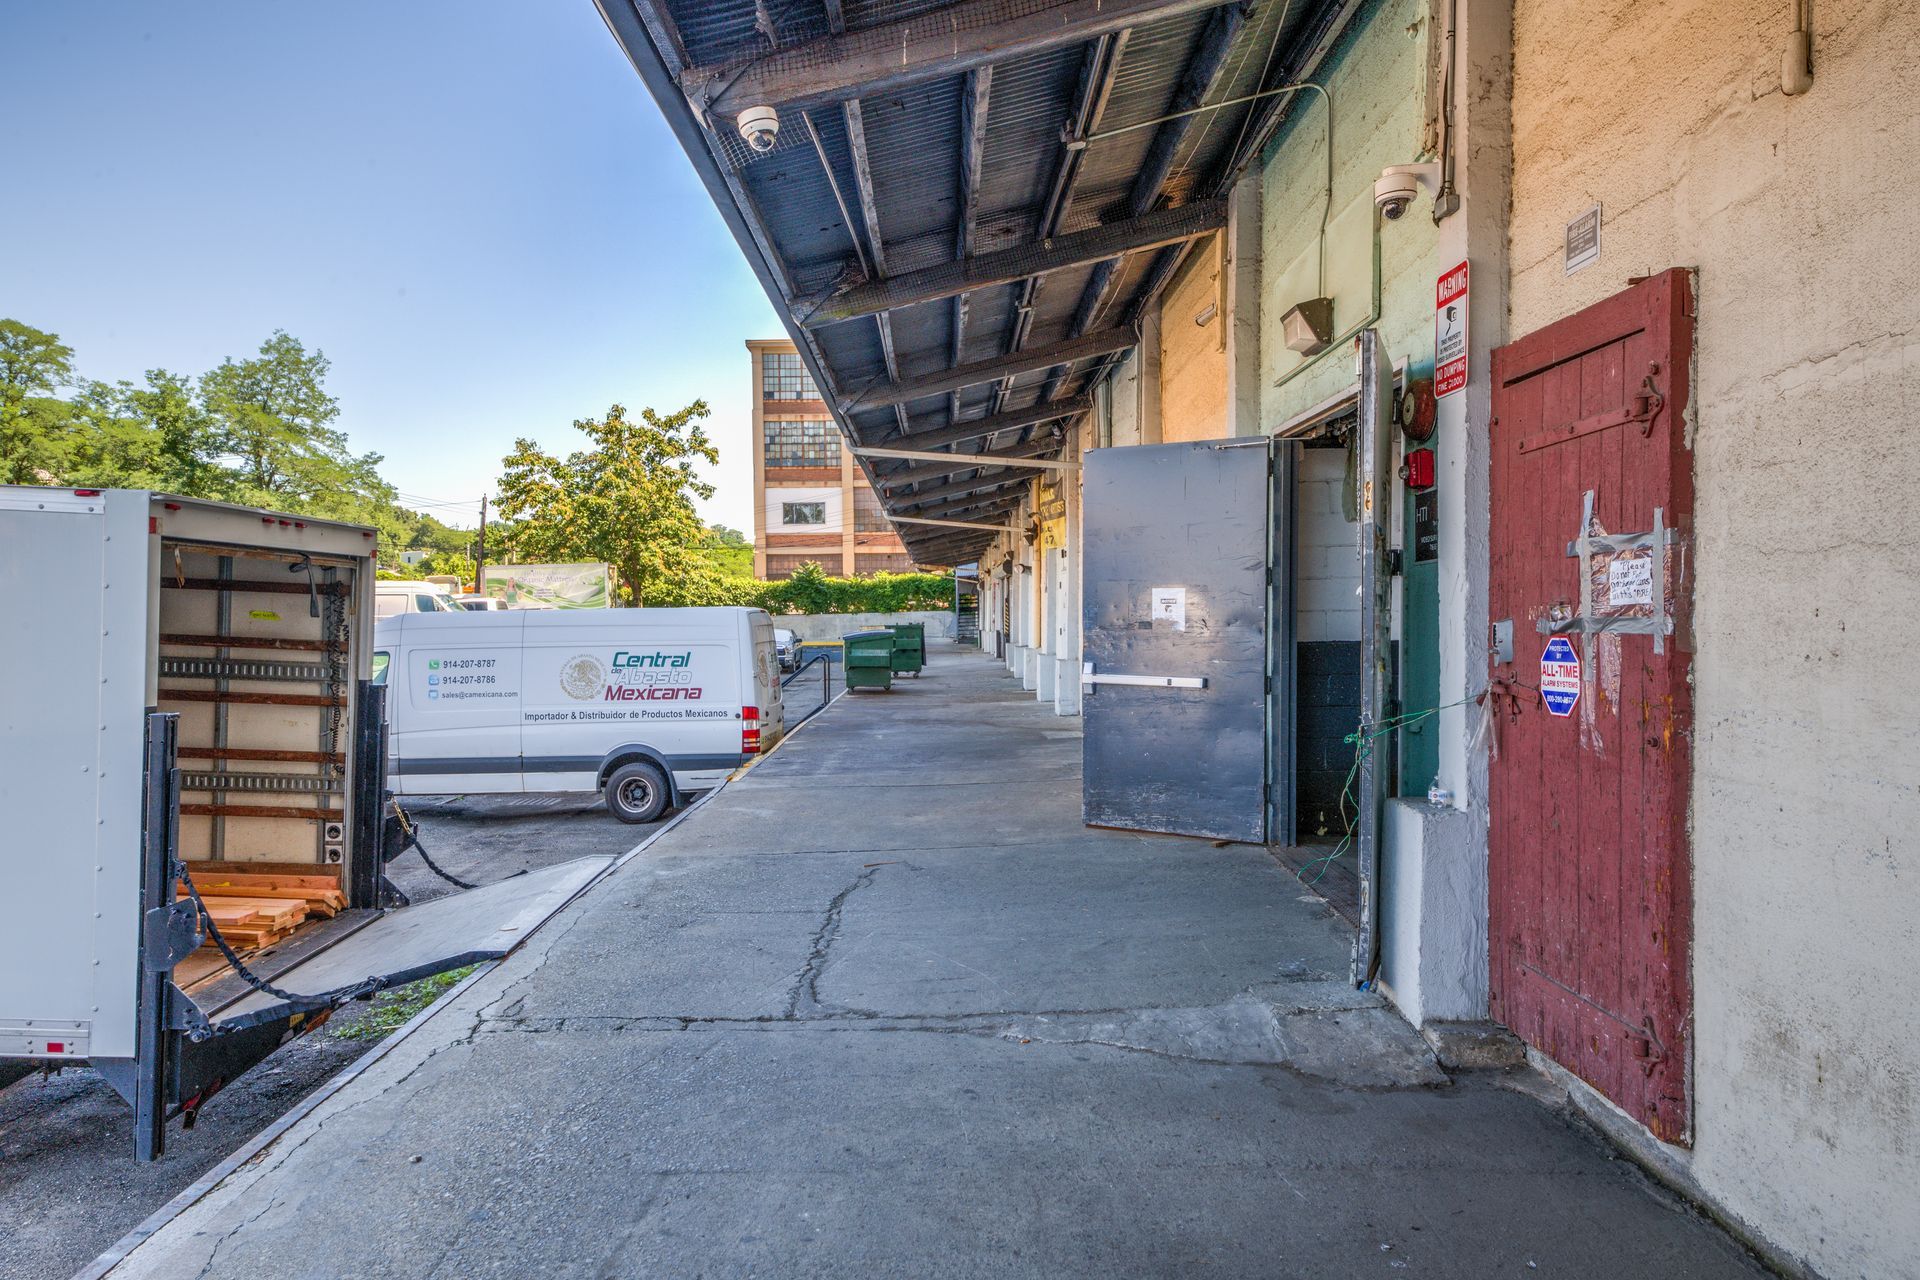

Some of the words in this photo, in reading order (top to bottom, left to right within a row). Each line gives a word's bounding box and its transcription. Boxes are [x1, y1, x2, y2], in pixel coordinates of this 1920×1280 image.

[1438, 268, 1467, 303] WARNING
[1444, 358, 1465, 379] DUMPING
[1438, 381, 1447, 393] FINE
[443, 659, 496, 669] 914-207-8787
[612, 651, 691, 667] Central
[615, 667, 692, 685] Abasto
[1542, 664, 1578, 678] ALL-TIME
[442, 675, 496, 685] 914-207-8786
[1557, 681, 1578, 689] SYSTEMS
[441, 690, 519, 700] sales@camexicana.com
[604, 685, 702, 701] Mexicana
[524, 712, 569, 722] Importador
[571, 711, 577, 720] &
[579, 711, 627, 720] Distribuidor
[629, 710, 640, 719] de
[641, 710, 683, 719] Productos
[685, 709, 728, 718] Mexicanos
